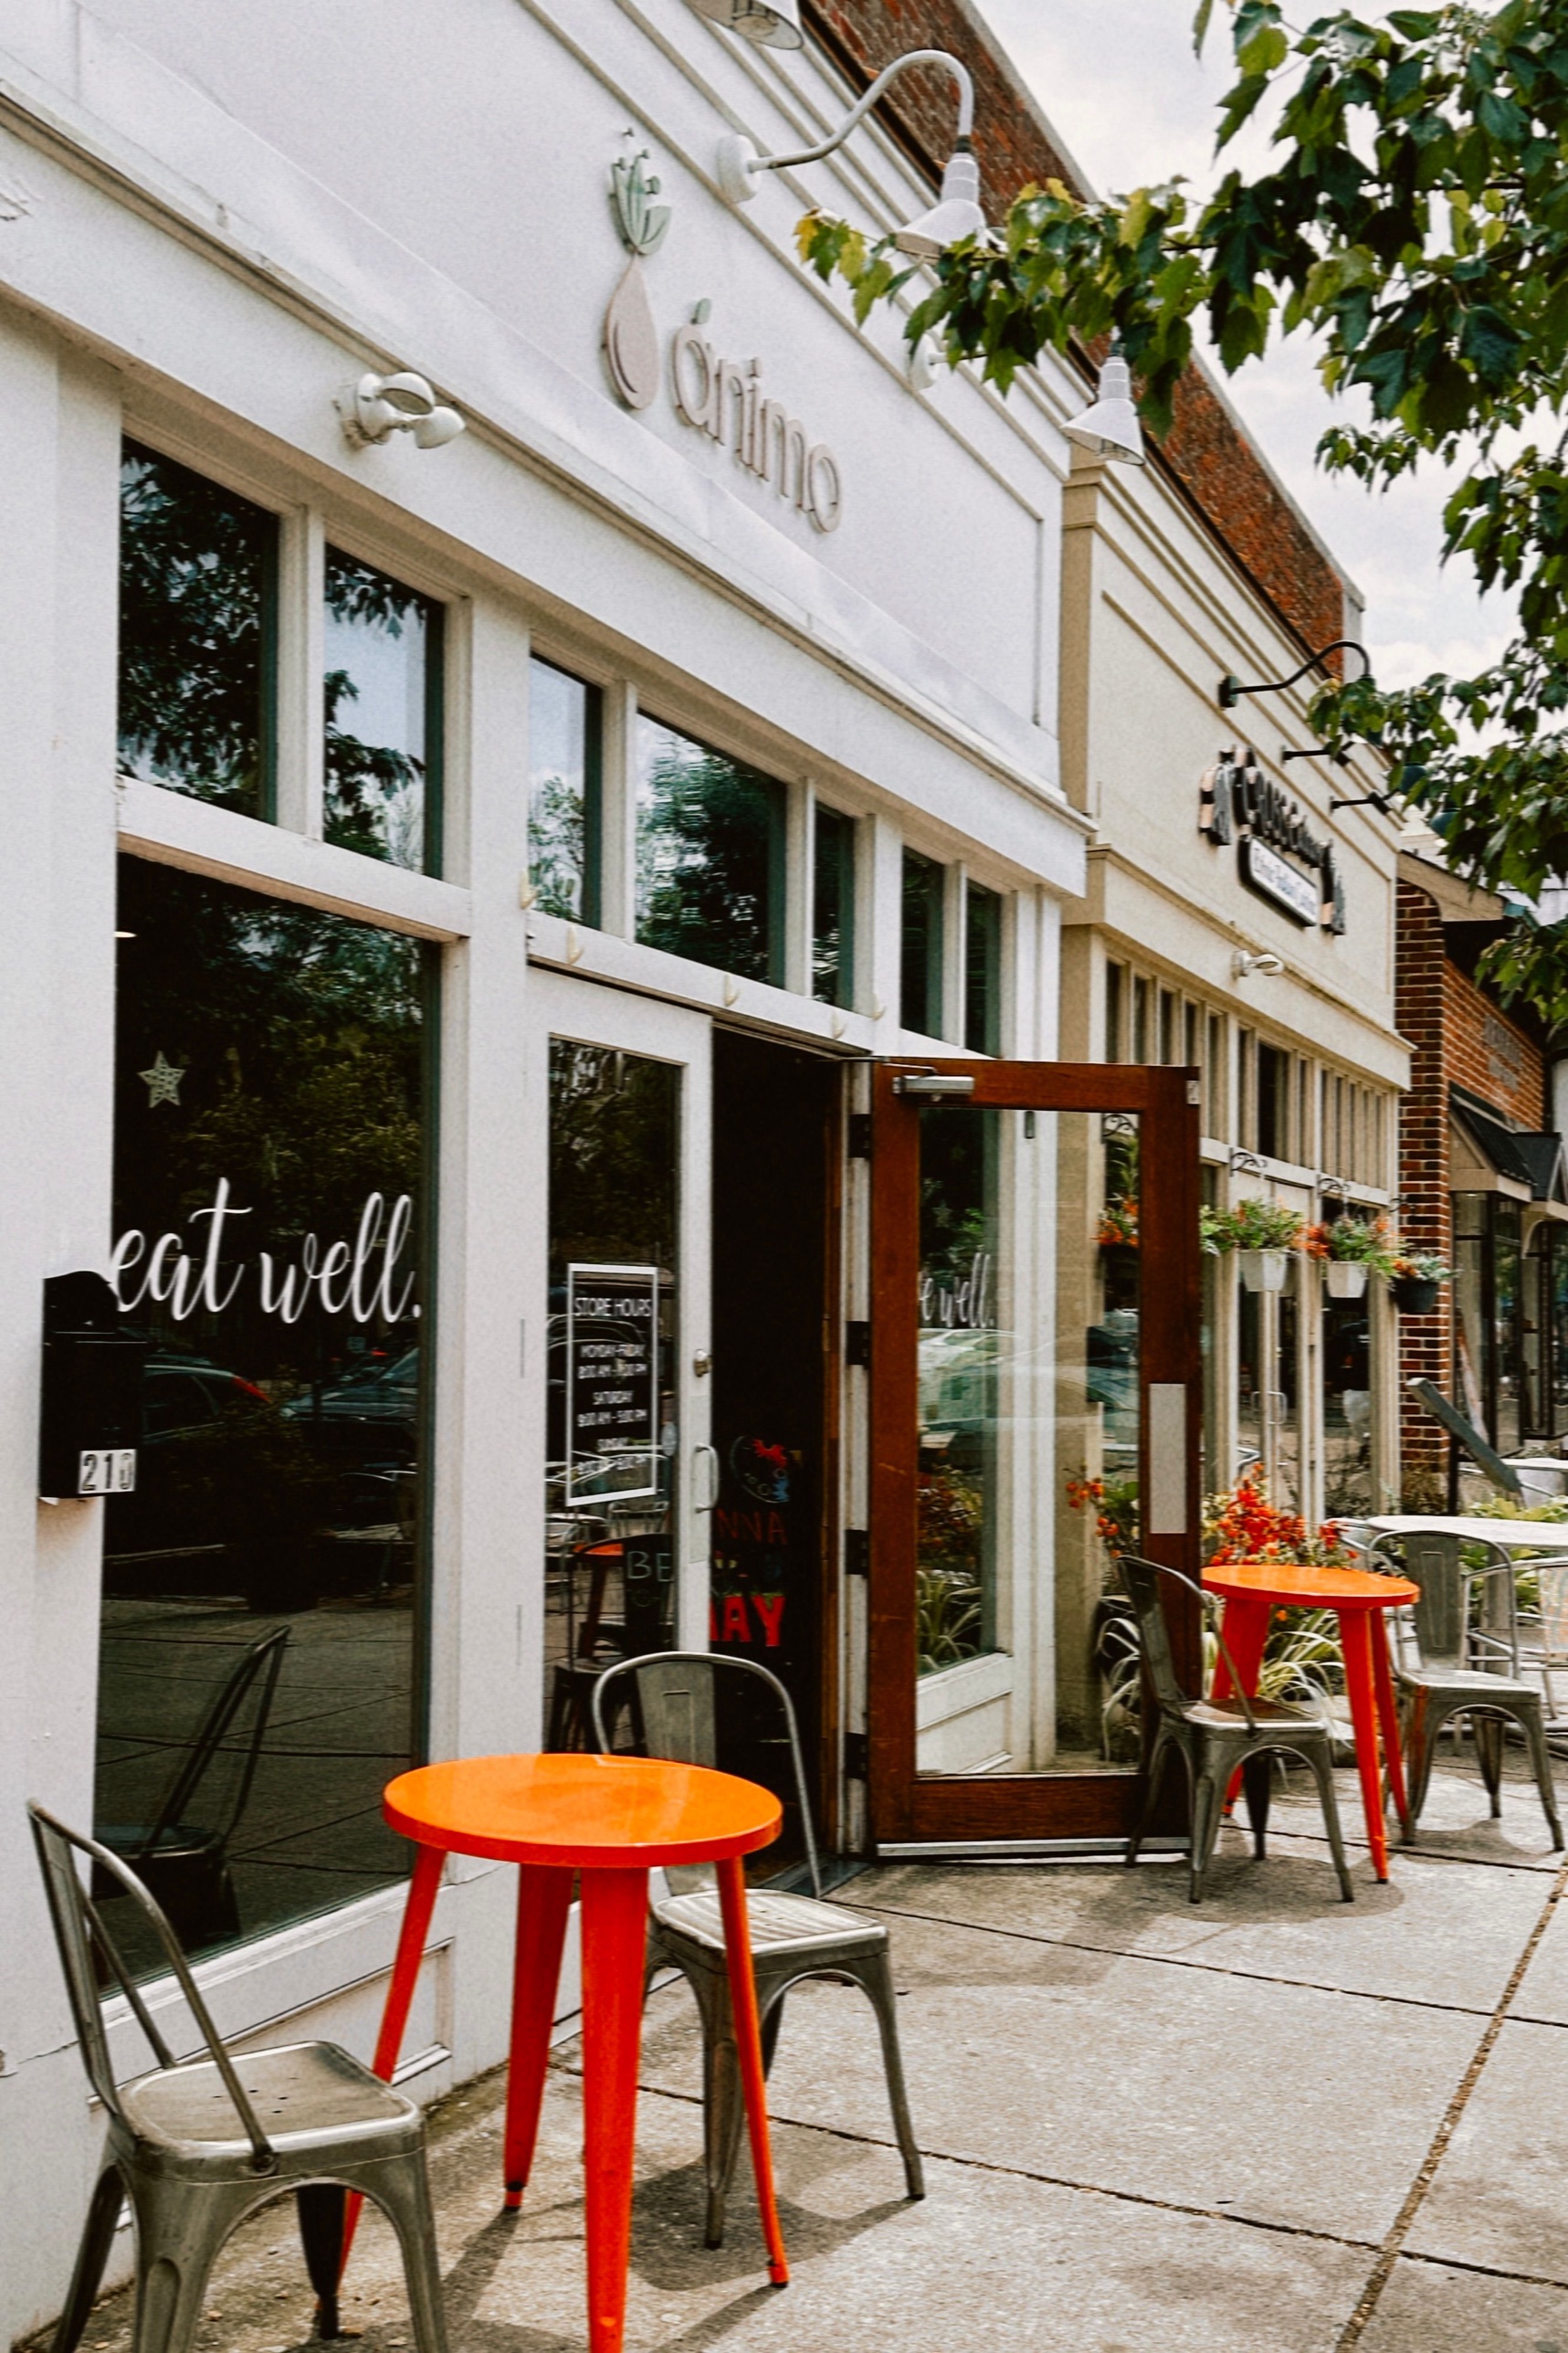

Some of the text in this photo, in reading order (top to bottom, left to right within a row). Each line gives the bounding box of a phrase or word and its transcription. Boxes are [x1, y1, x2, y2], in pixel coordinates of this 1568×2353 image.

[110, 1176, 422, 1324] eat well.
[574, 1297, 652, 1317] STORE HOURS
[593, 1390, 634, 1406] SATURDAY
[626, 1550, 674, 1583] BE
